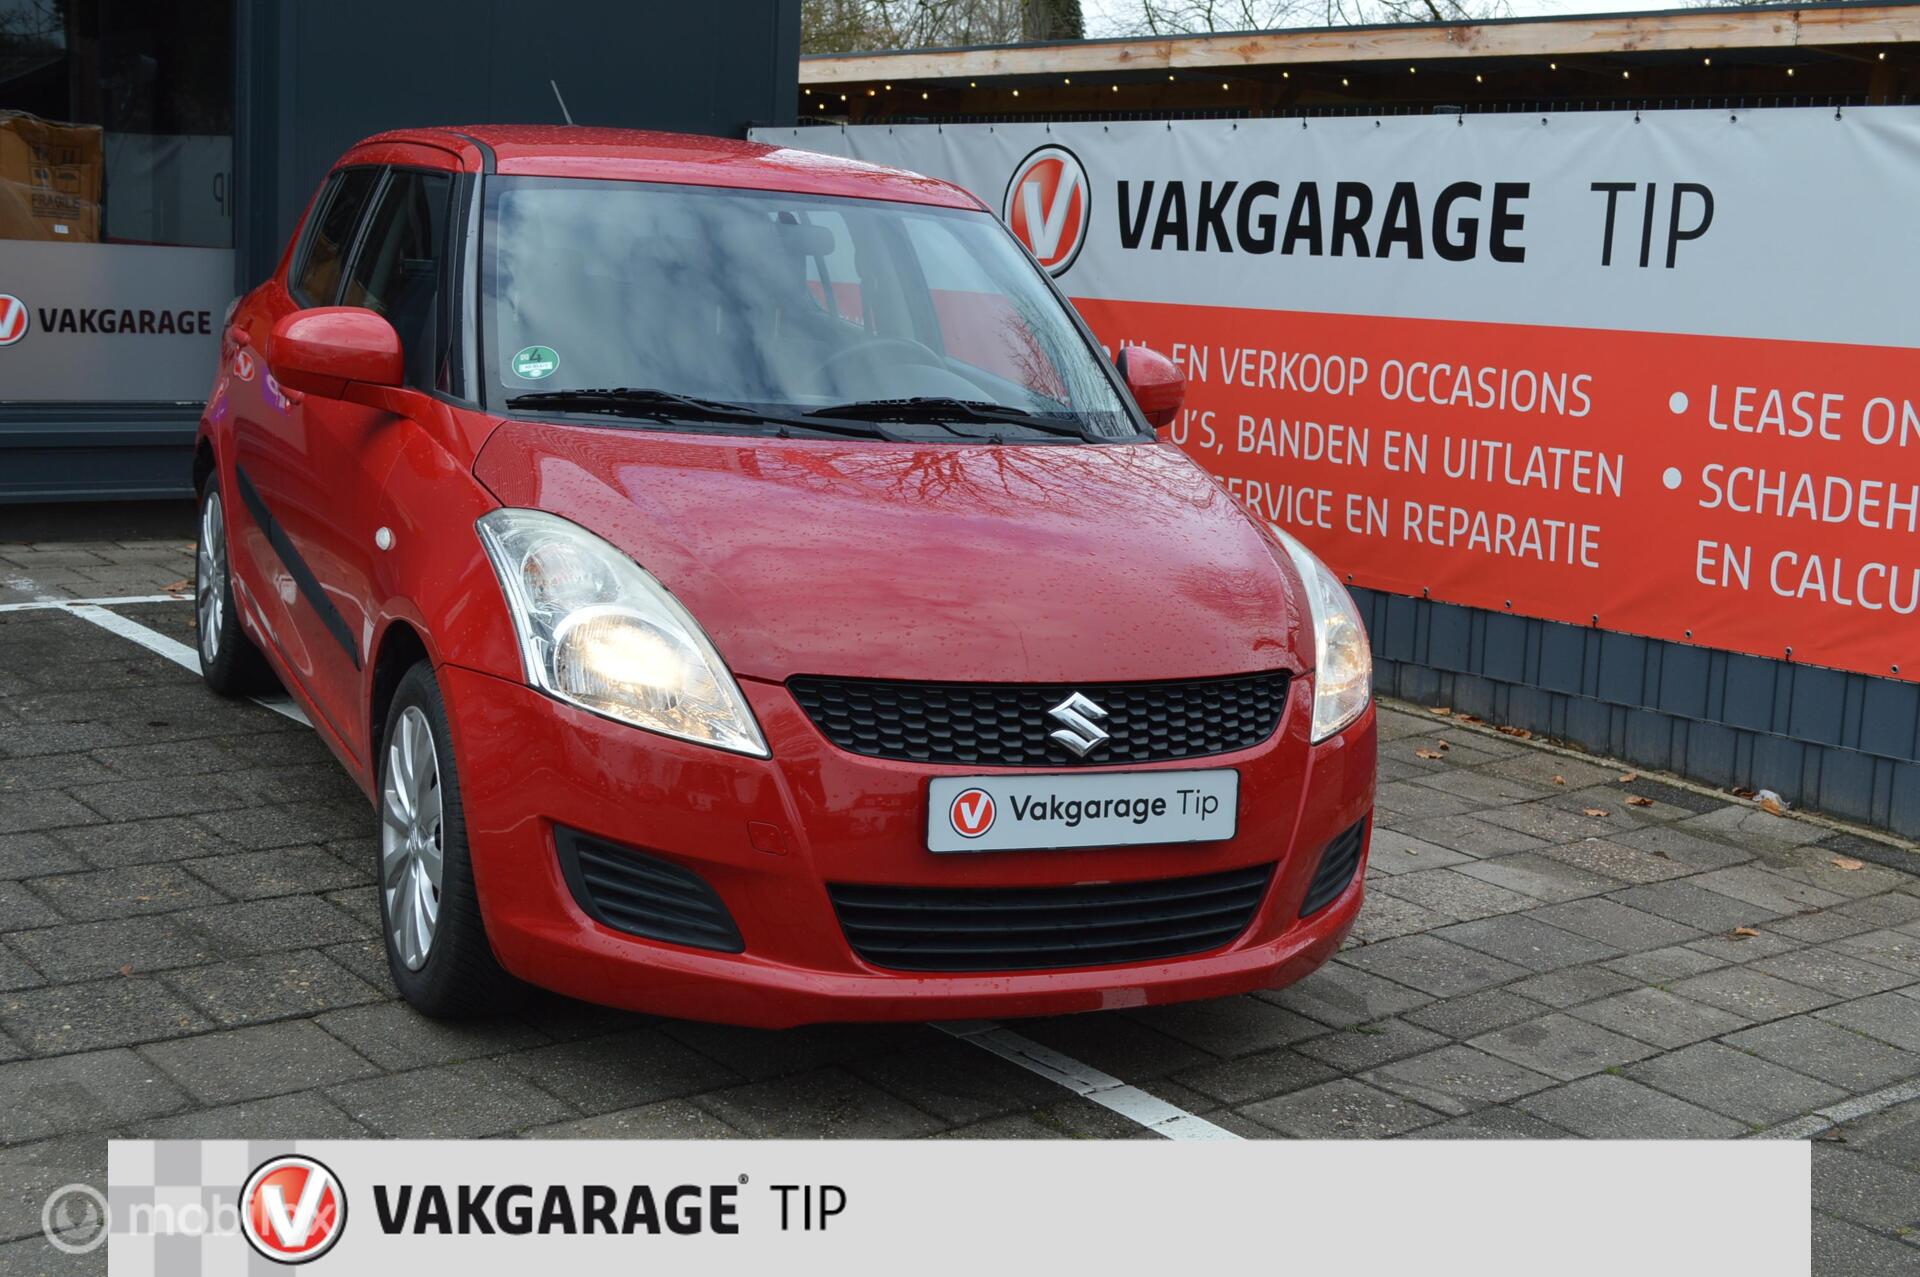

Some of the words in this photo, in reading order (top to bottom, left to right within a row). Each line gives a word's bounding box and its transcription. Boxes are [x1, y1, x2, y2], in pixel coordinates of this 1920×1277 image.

[1116, 180, 1531, 263] VAKGARAGE
[1589, 182, 1715, 269] TIP
[38, 308, 212, 335] VAKGARAGE
[1219, 347, 1369, 397] VERKOOP
[1380, 359, 1593, 417] OCCASIONS
[1708, 384, 1844, 441] LEASE
[1170, 408, 1224, 456] U'S,
[1237, 414, 1370, 467] BANDEN
[1383, 430, 1429, 474] EN
[1443, 436, 1624, 498] UITLATEN
[1213, 474, 1333, 529] ERVICE
[1346, 493, 1389, 538] EN
[1402, 500, 1601, 568] REPARATIE
[1699, 463, 1919, 533] SCHADEH
[1696, 539, 1752, 591] EN
[1770, 550, 1920, 615] CALCU
[1008, 794, 1168, 828] Vakgarage
[1176, 788, 1219, 821] Tip
